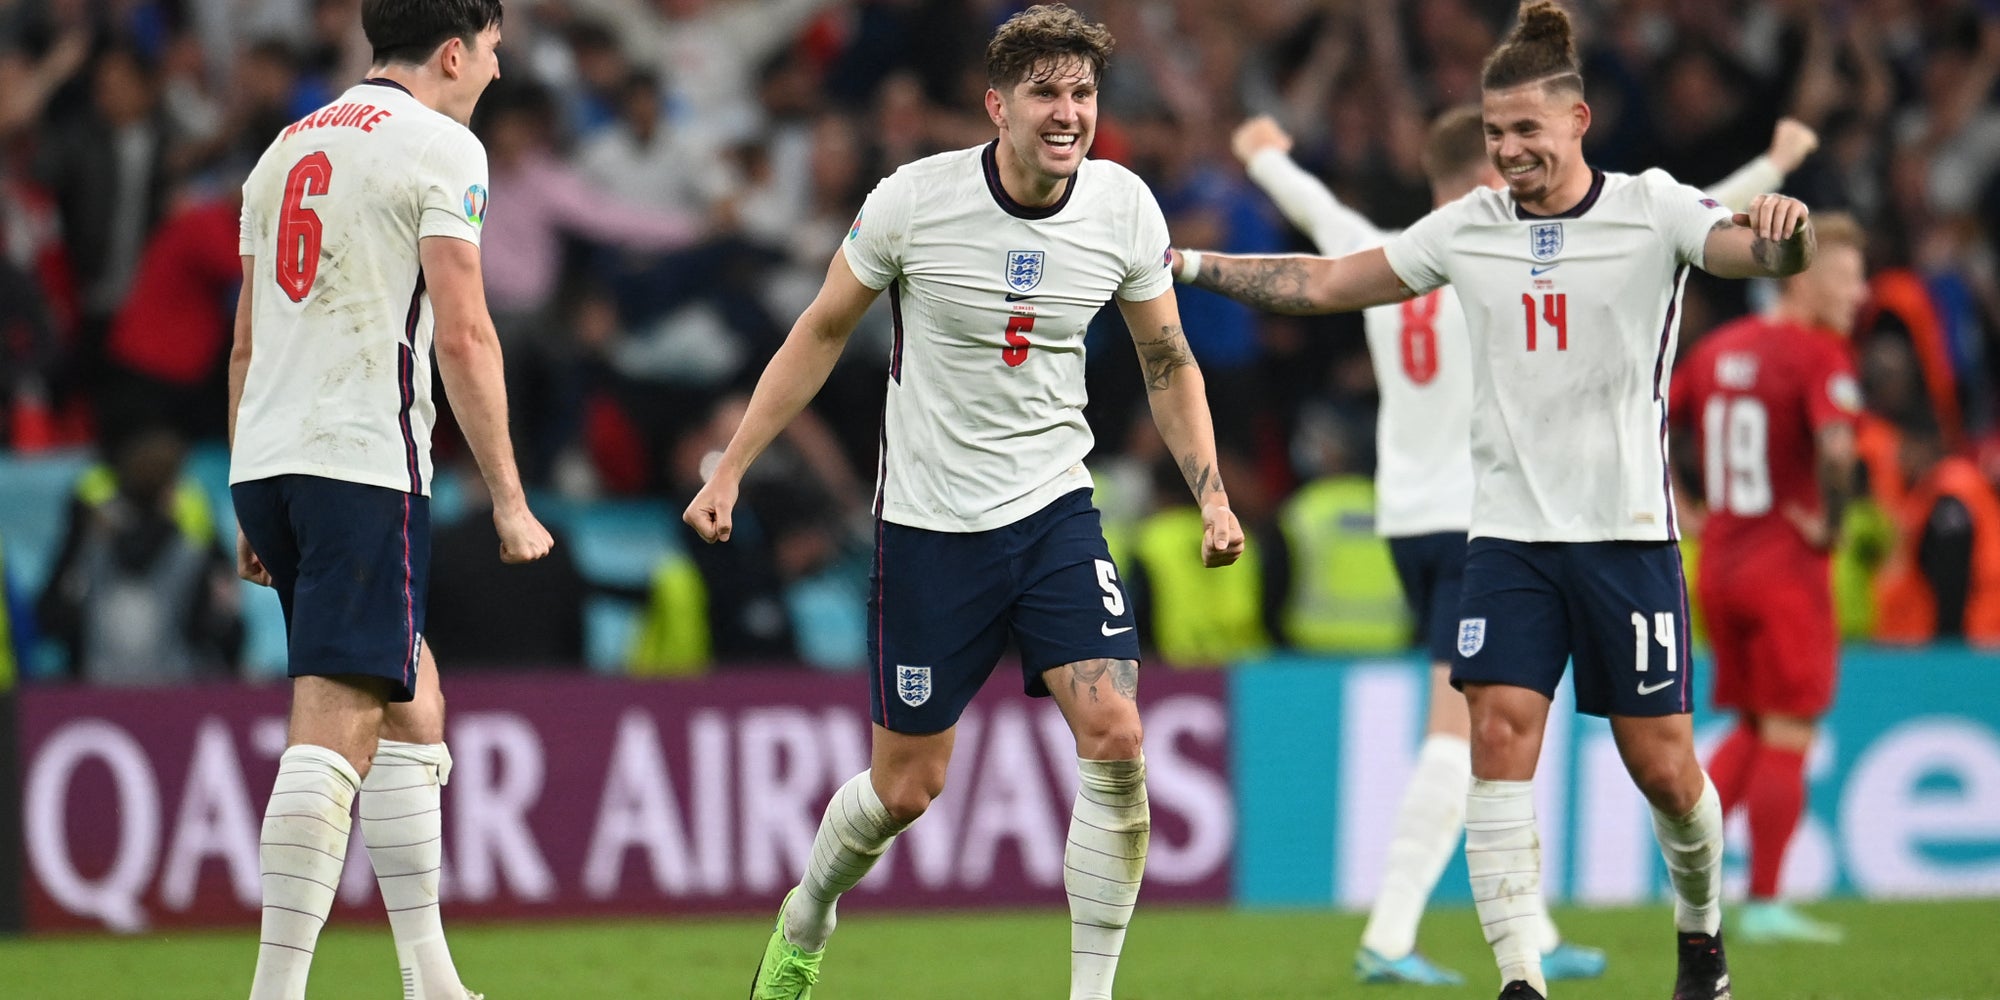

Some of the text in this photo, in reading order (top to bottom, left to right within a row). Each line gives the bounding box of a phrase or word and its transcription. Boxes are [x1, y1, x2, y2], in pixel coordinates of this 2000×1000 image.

[282, 102, 392, 143] MAGUIRE
[276, 150, 333, 303] 6
[1002, 316, 1035, 367] 5
[1399, 287, 1441, 386] 8
[1522, 293, 1568, 351] 14
[1703, 394, 1773, 517] 19
[1094, 559, 1125, 617] 5
[1631, 611, 1677, 672] 14
[25, 716, 556, 933] QAR
